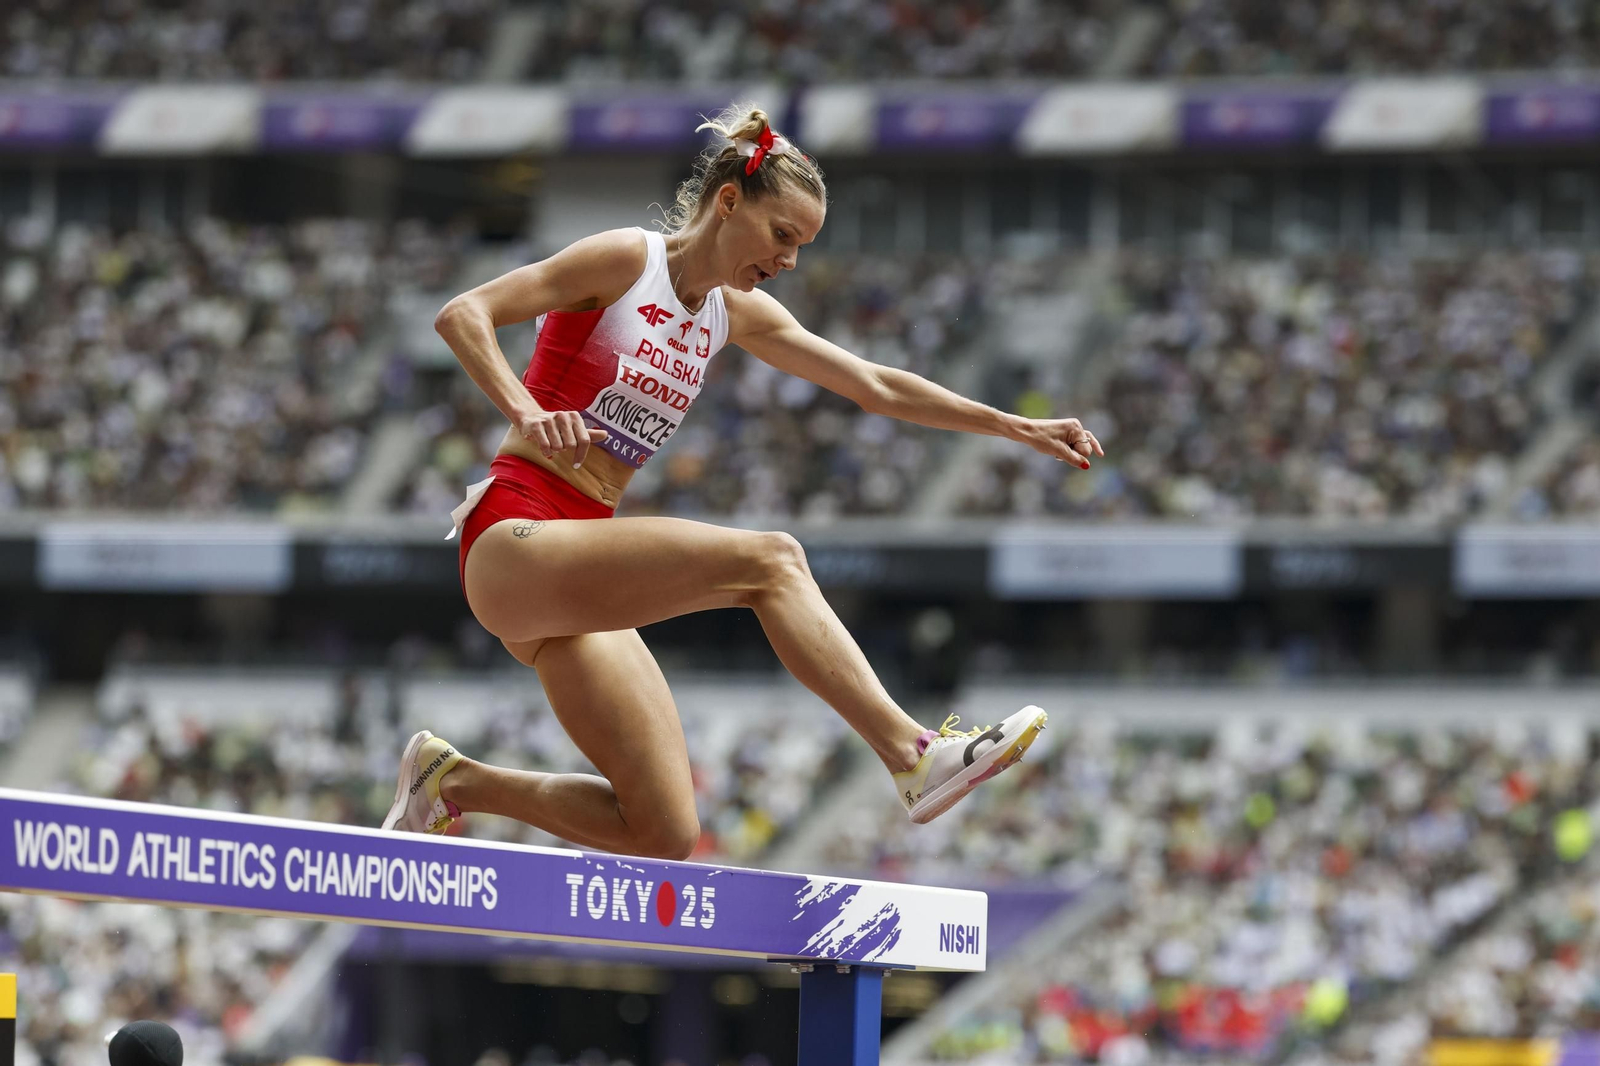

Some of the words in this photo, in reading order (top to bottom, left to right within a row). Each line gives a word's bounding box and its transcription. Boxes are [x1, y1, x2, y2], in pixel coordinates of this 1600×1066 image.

[637, 303, 675, 328] 4F
[667, 337, 689, 355] ORLEN
[635, 338, 700, 389] POLSKA
[440, 748, 455, 762] ON
[410, 758, 442, 796] RUNNING
[14, 819, 120, 876] WORLD
[127, 831, 277, 891] ATHLETICS
[283, 846, 499, 911] CHAMPIONSHIPS
[939, 922, 981, 955] NISHI
